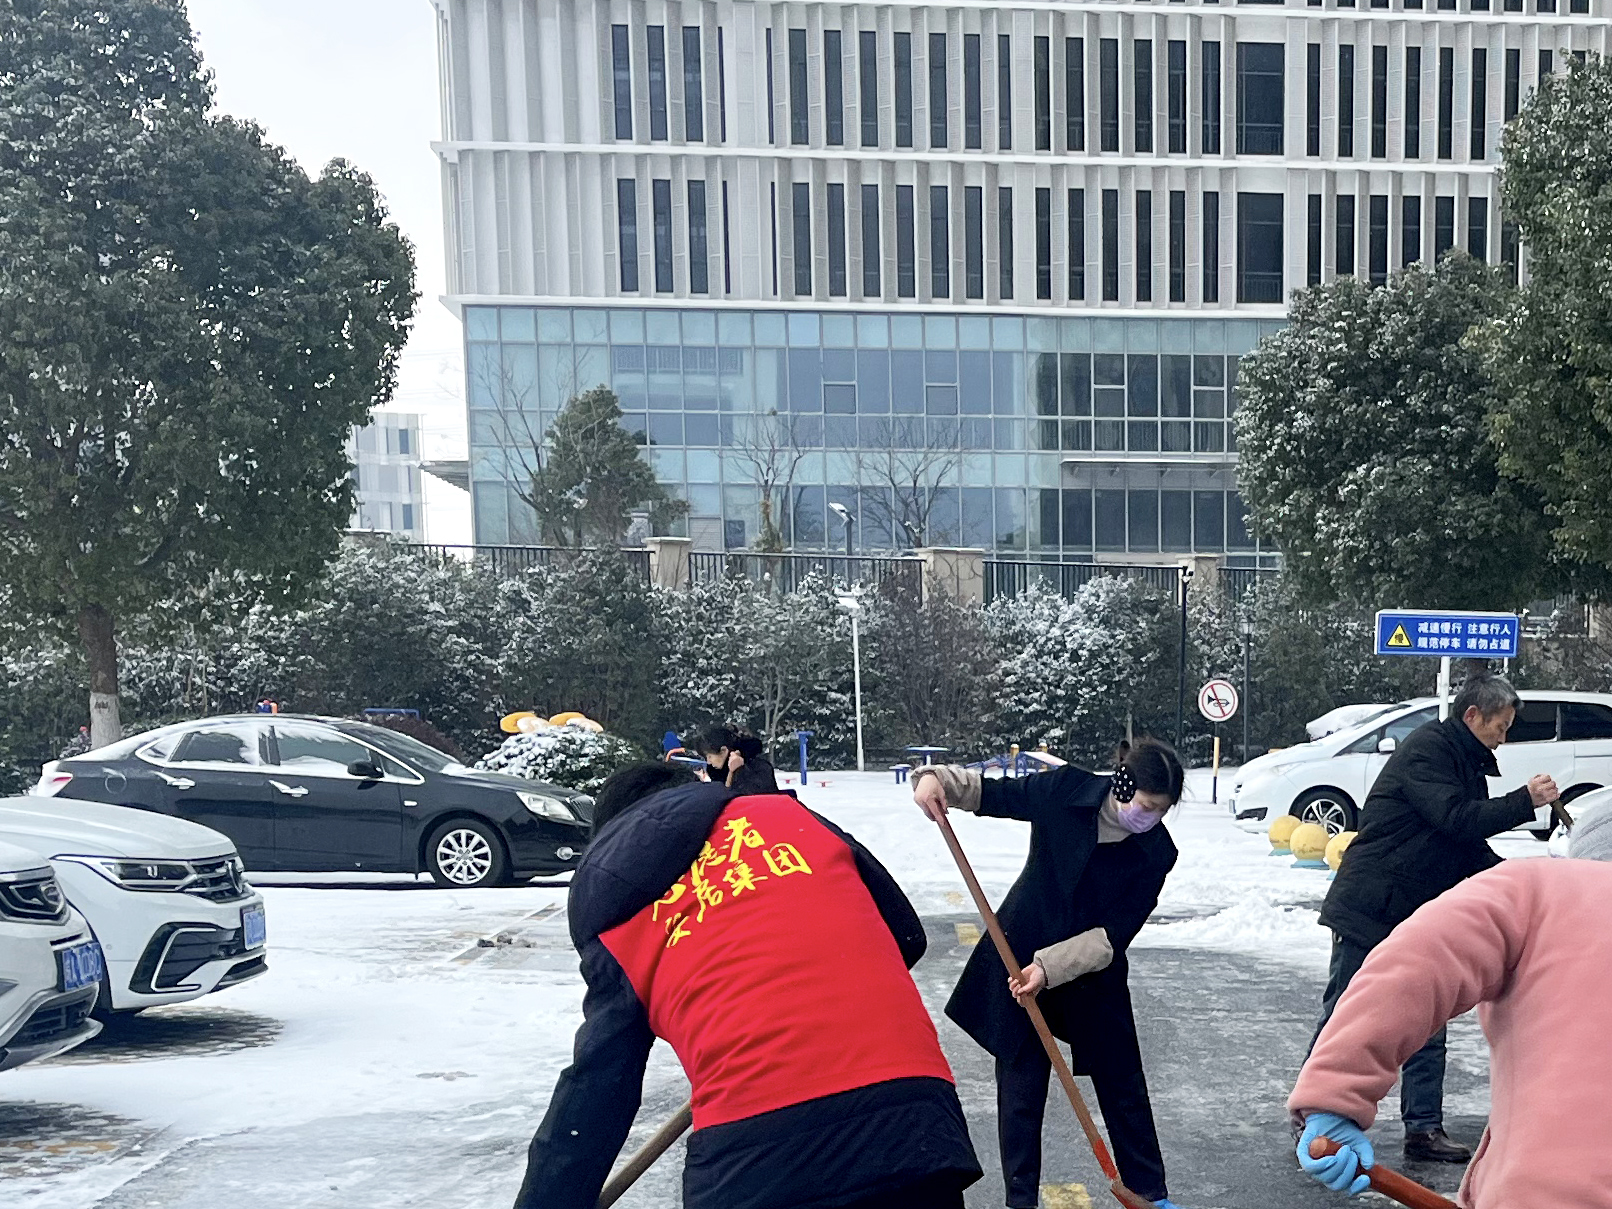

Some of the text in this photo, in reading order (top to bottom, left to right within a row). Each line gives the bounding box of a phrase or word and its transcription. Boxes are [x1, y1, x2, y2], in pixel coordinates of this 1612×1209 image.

[1417, 622, 1512, 635] 减速慢行 注意行人
[1417, 637, 1510, 650] 规范停车 请勿占道
[665, 842, 813, 948] 安居集团
